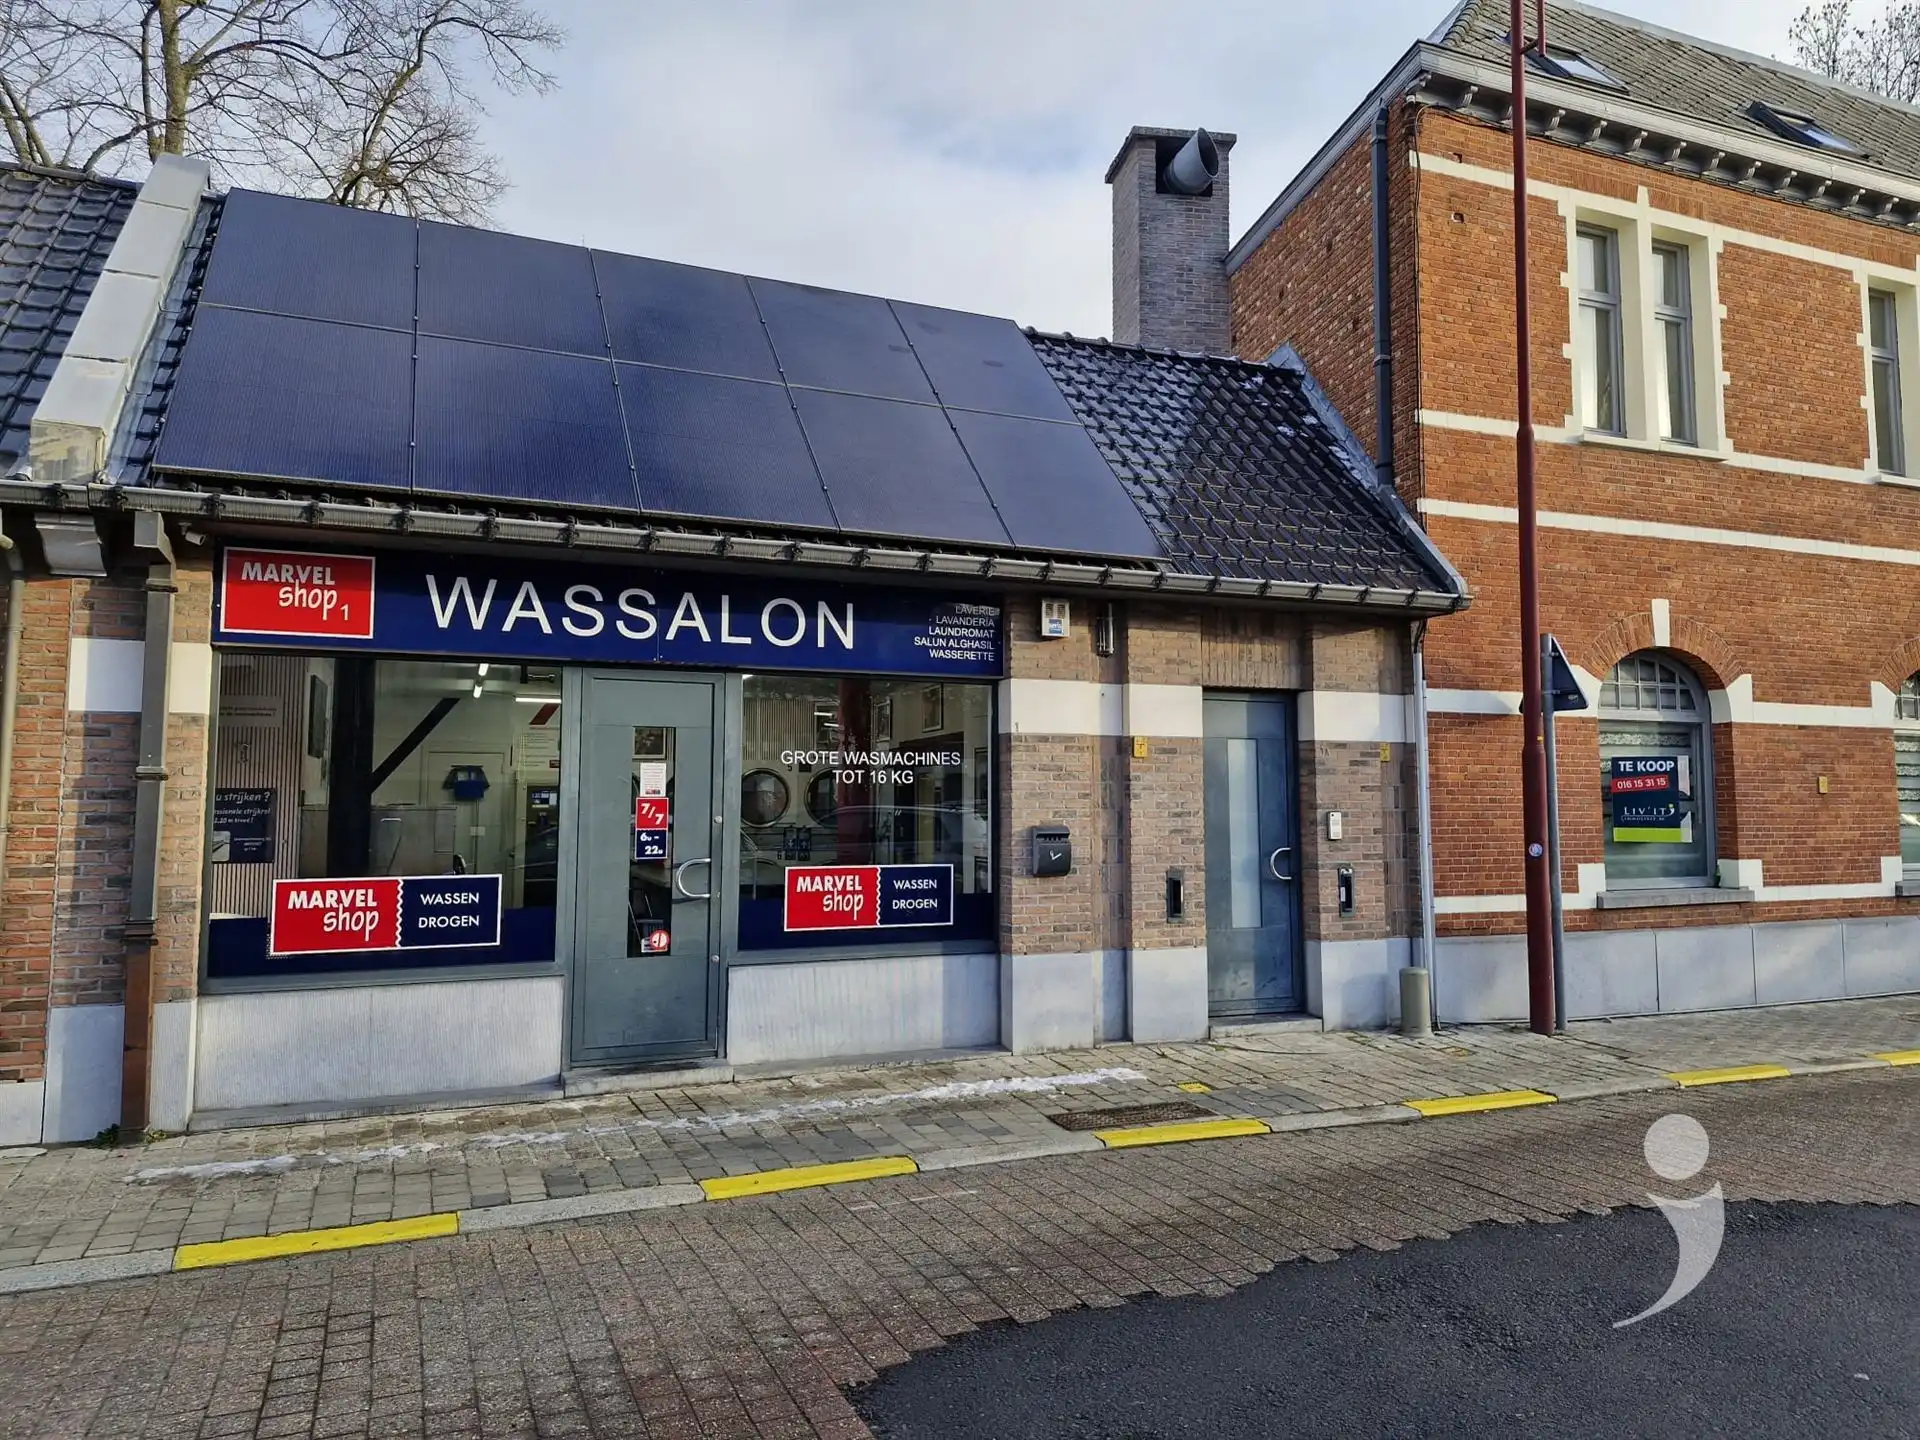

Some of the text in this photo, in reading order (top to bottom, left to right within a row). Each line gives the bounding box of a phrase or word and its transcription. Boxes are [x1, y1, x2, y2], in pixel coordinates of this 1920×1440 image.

[241, 562, 335, 585] MARVEL
[278, 579, 349, 621] shop 1
[425, 574, 855, 650] WASSALON
[955, 604, 996, 616] LAVERIE
[928, 626, 995, 638] LAUNDROMAT
[914, 636, 995, 650] SALUN ALGHASIL
[929, 648, 995, 661] WASSERETTE
[780, 750, 961, 766] GROTE WASMACHINES
[1618, 760, 1675, 772] TE KOOP
[832, 769, 914, 785] TOT 16 KG
[1617, 777, 1666, 789] 016 15 31 15
[223, 791, 262, 804] strijken
[640, 802, 665, 825] 7/7
[644, 845, 664, 855] 22u
[796, 875, 863, 892] MARVEL
[893, 879, 938, 890] WASSEN
[287, 888, 377, 910] MARVEL
[420, 892, 480, 905] WASSEN
[822, 887, 864, 921] shop
[892, 898, 938, 910] DROGEN
[323, 903, 379, 941] shop
[418, 915, 480, 929] DROGEN
